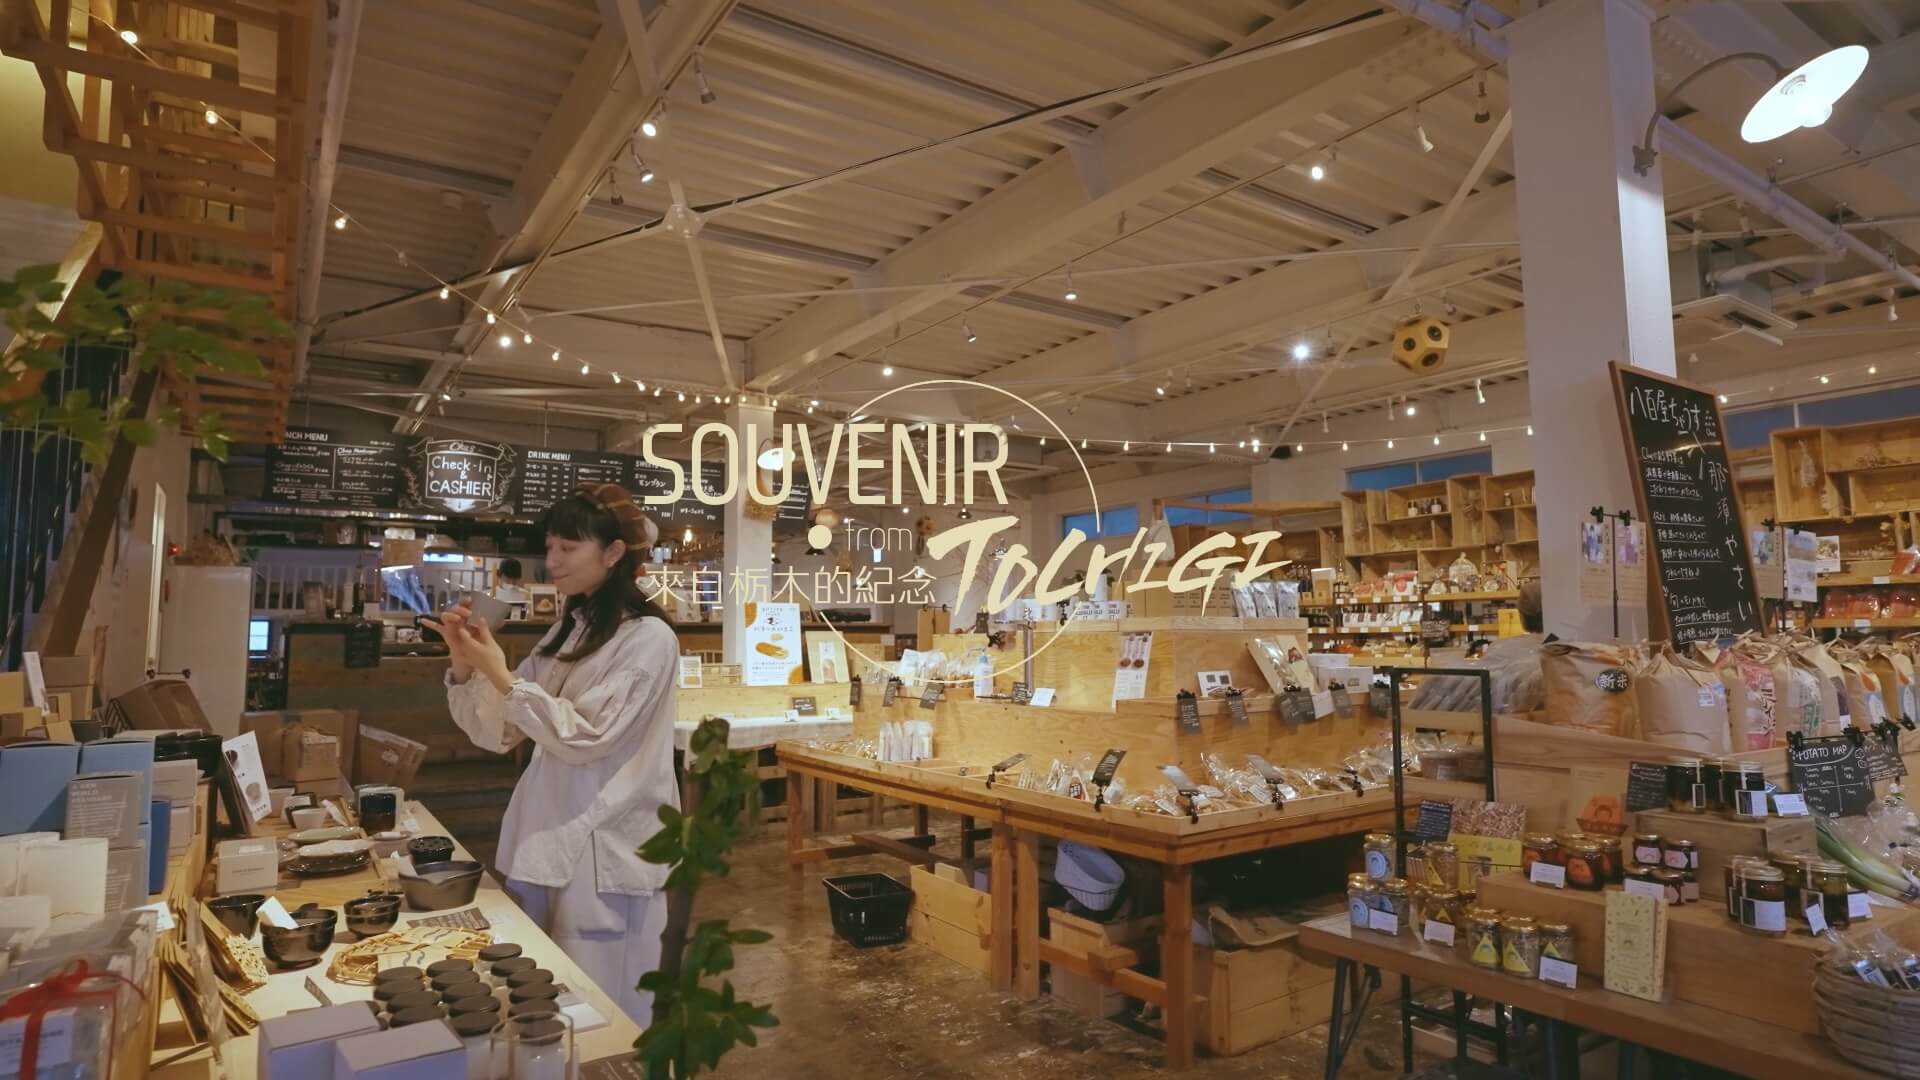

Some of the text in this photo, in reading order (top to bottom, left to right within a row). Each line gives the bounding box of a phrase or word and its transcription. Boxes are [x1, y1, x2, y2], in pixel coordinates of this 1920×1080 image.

[304, 432, 328, 441] MENU
[527, 450, 571, 461] DRINK MENU
[431, 455, 492, 474] Check-In
[460, 470, 468, 480] &
[429, 480, 492, 497] CASHIER
[1599, 673, 1628, 689] 新米
[1833, 744, 1848, 755] MAP
